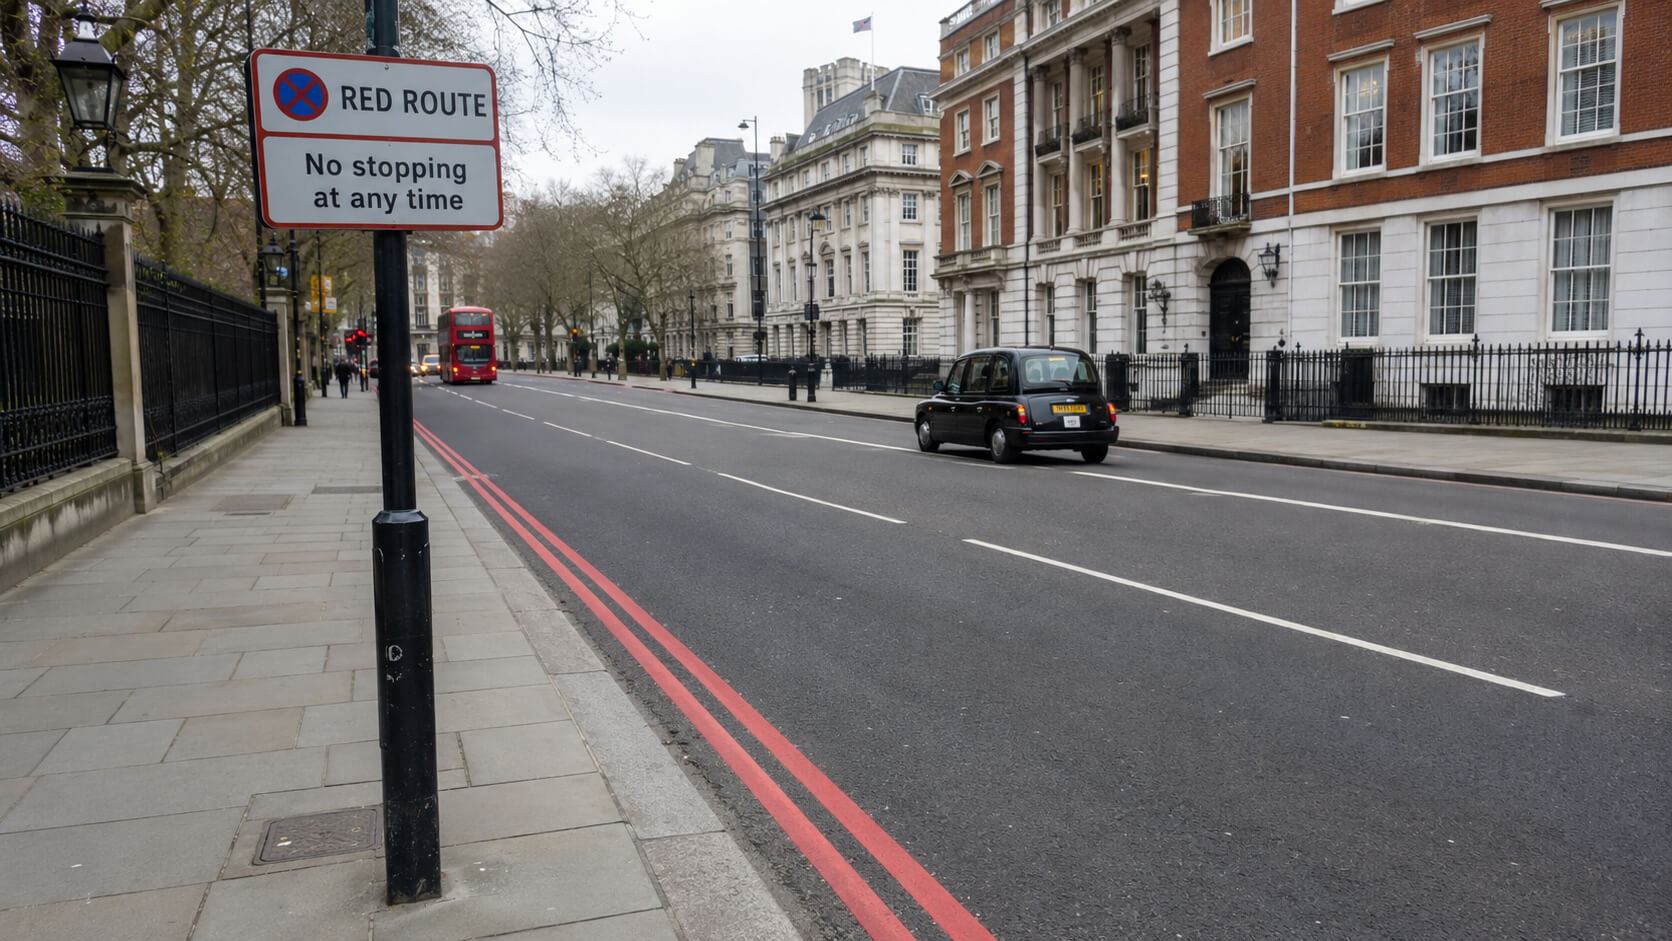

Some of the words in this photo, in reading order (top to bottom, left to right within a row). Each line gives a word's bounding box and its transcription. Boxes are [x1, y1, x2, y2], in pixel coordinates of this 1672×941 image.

[341, 85, 392, 112] RED
[403, 89, 487, 117] ROUTE
[305, 153, 342, 176] No
[353, 156, 466, 184] stopping
[314, 187, 340, 208] at
[350, 191, 397, 214] any
[407, 188, 463, 210] time
